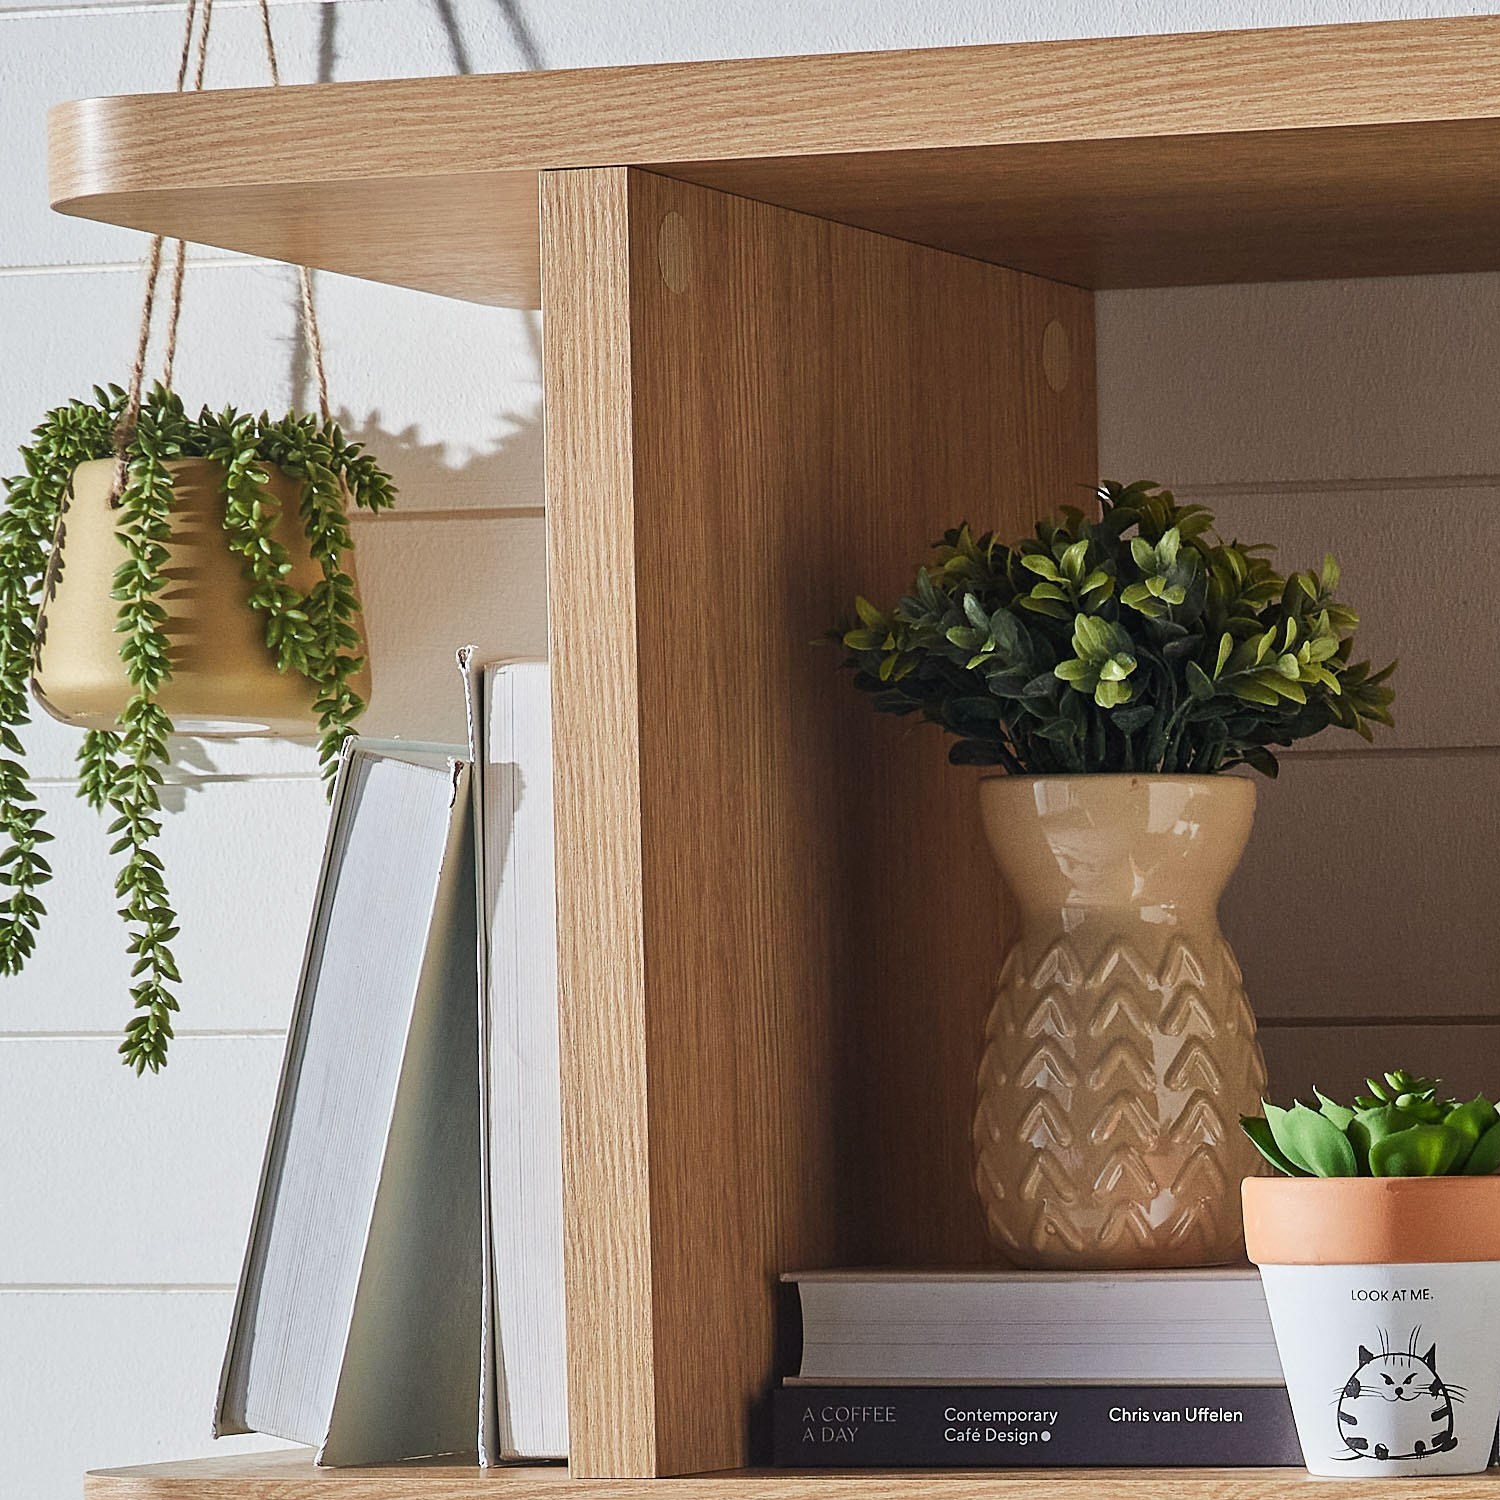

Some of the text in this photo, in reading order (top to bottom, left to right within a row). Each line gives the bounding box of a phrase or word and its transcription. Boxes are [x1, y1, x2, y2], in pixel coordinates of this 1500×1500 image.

[1351, 1288, 1434, 1301] LOOK AT ME.
[802, 1406, 897, 1422] A COFFEE
[944, 1407, 1059, 1425] Contemporary
[1108, 1407, 1243, 1422] Chris van Uffelen
[802, 1427, 859, 1442] A DAY
[944, 1427, 981, 1442] Café
